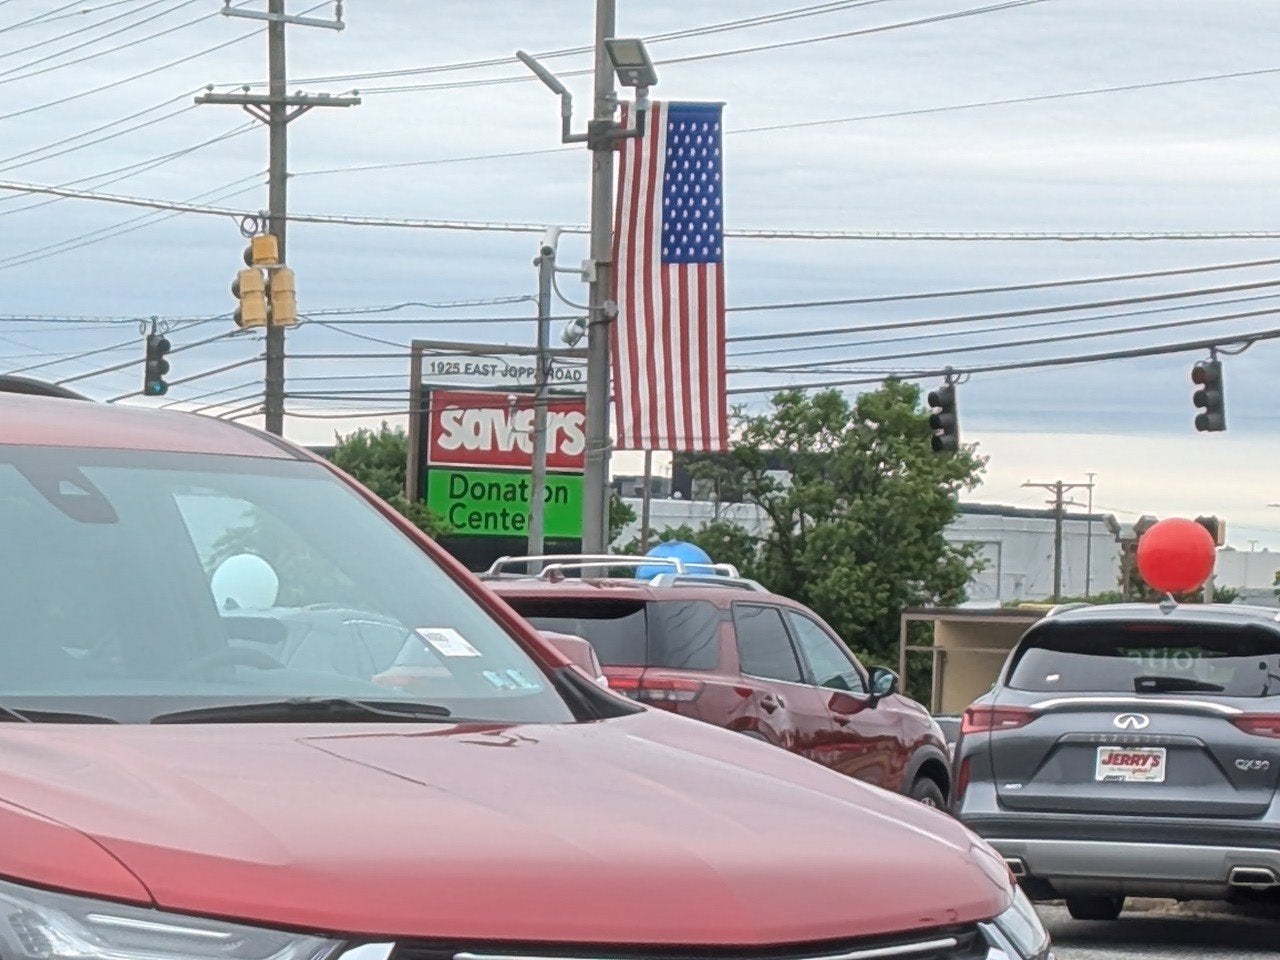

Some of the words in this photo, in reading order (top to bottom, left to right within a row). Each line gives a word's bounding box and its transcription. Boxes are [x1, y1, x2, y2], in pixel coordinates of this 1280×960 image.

[430, 361, 460, 375] 1925
[464, 362, 497, 376] EAST
[501, 365, 537, 380] JOPP
[449, 473, 568, 504] Donaton
[449, 502, 533, 531] Cente
[1101, 752, 1161, 768] JERRY'S
